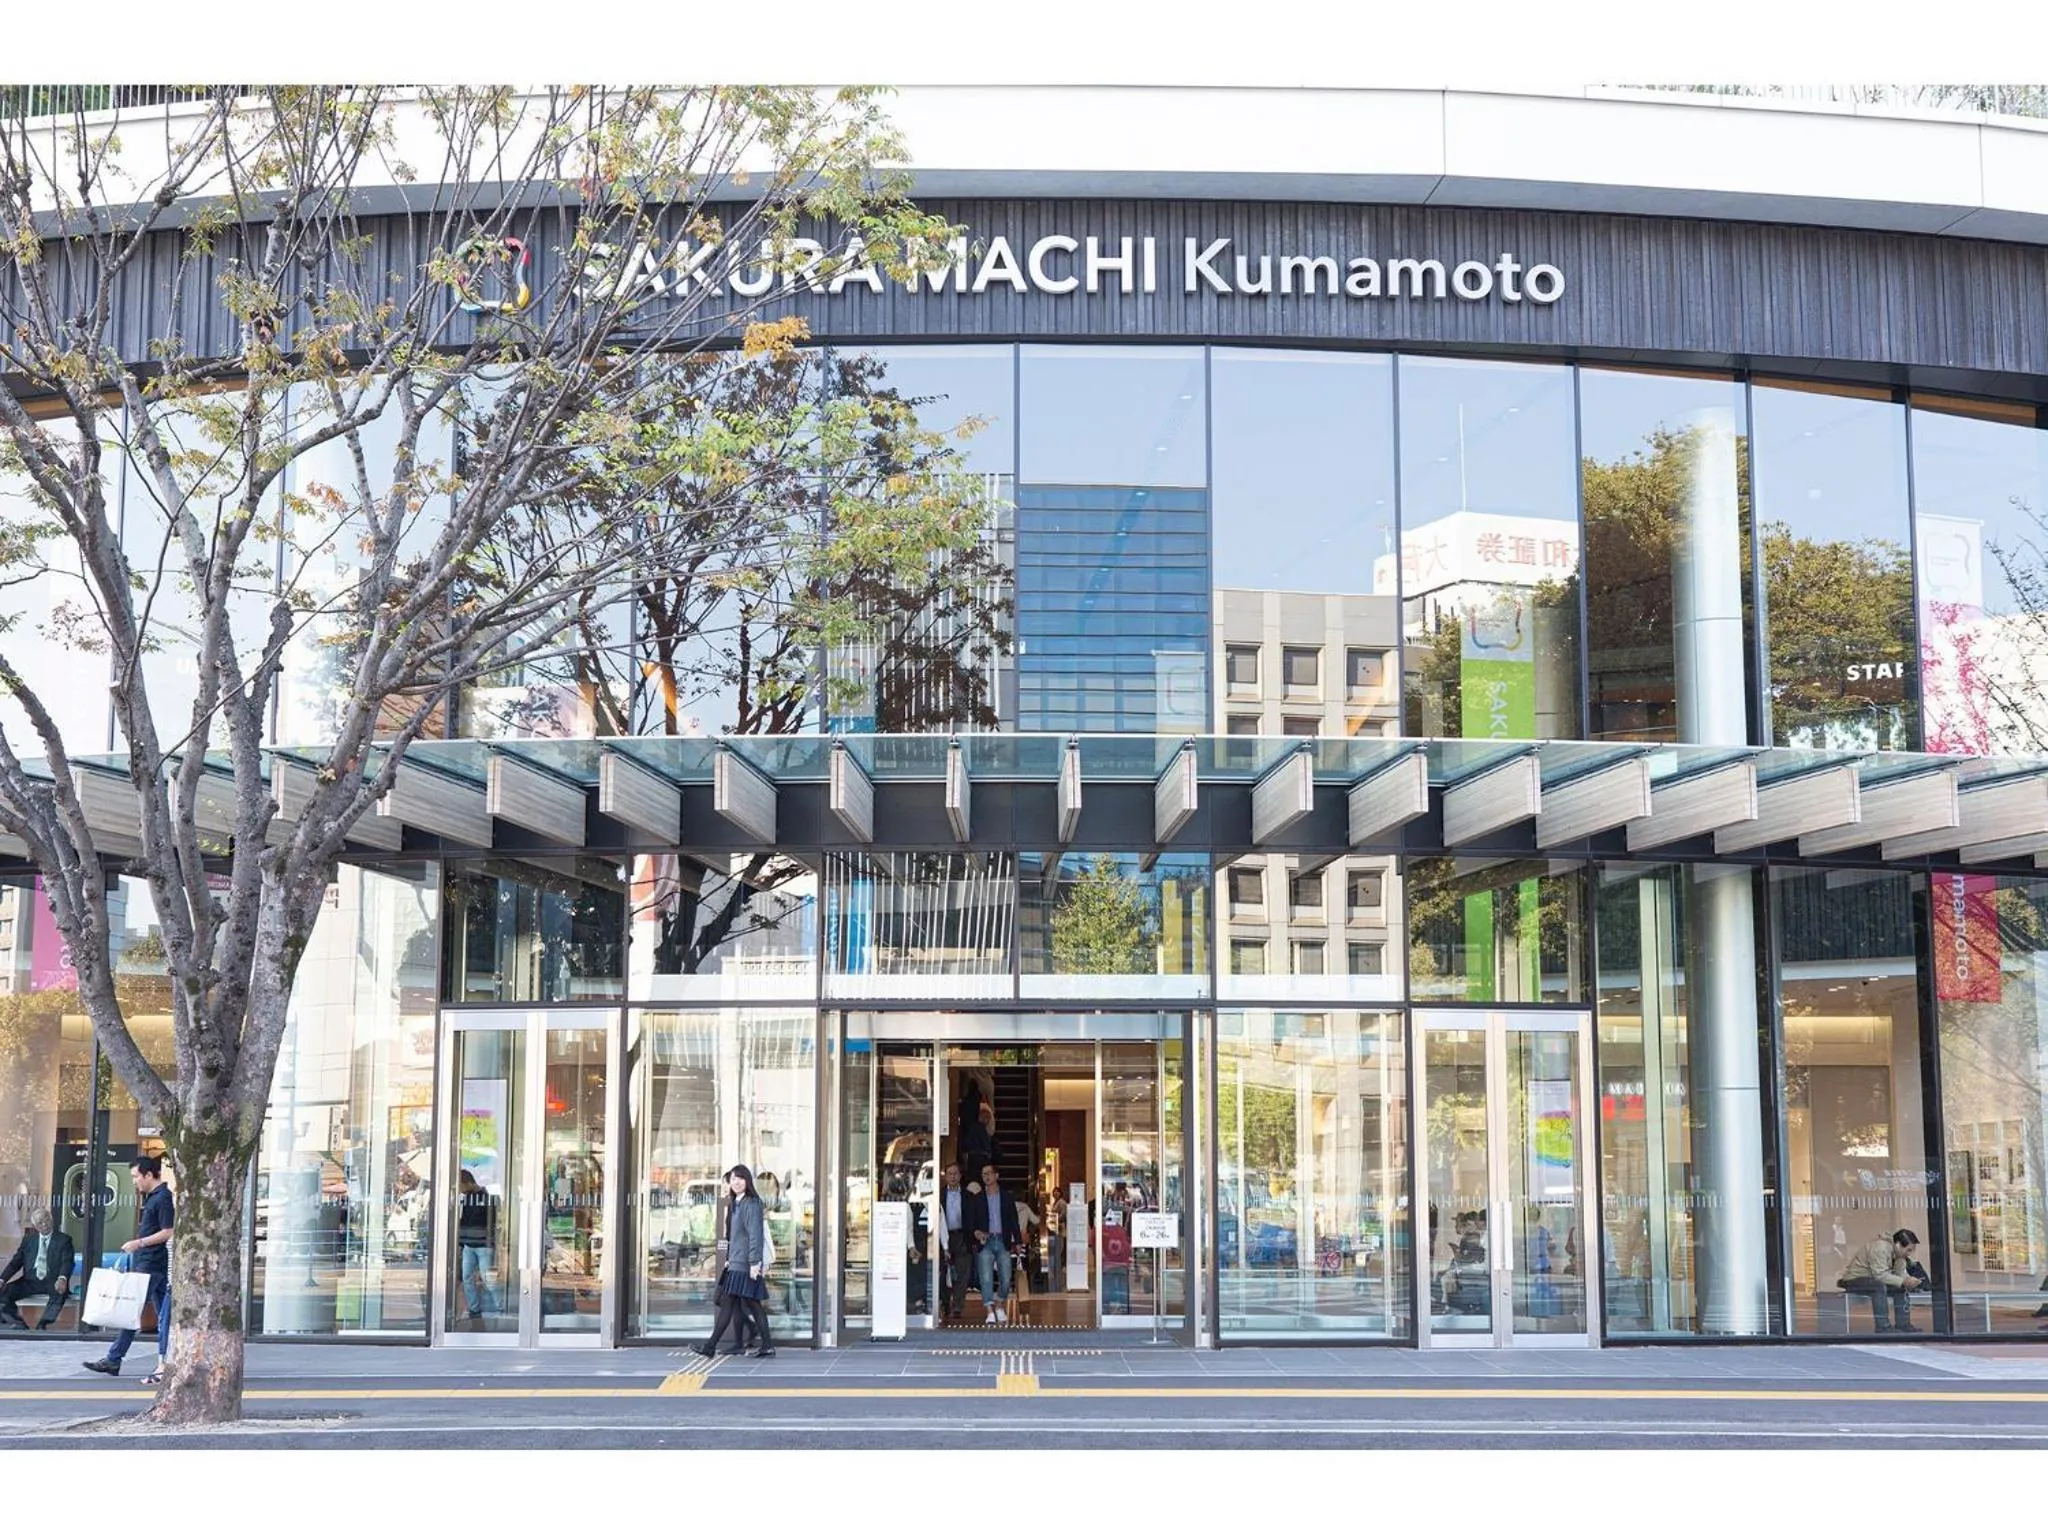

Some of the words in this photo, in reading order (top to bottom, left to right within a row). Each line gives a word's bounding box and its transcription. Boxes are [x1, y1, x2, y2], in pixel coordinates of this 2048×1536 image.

[574, 236, 884, 298] SAKURA
[906, 235, 1157, 295] MACHI
[1185, 237, 1566, 304] Kumamoto
